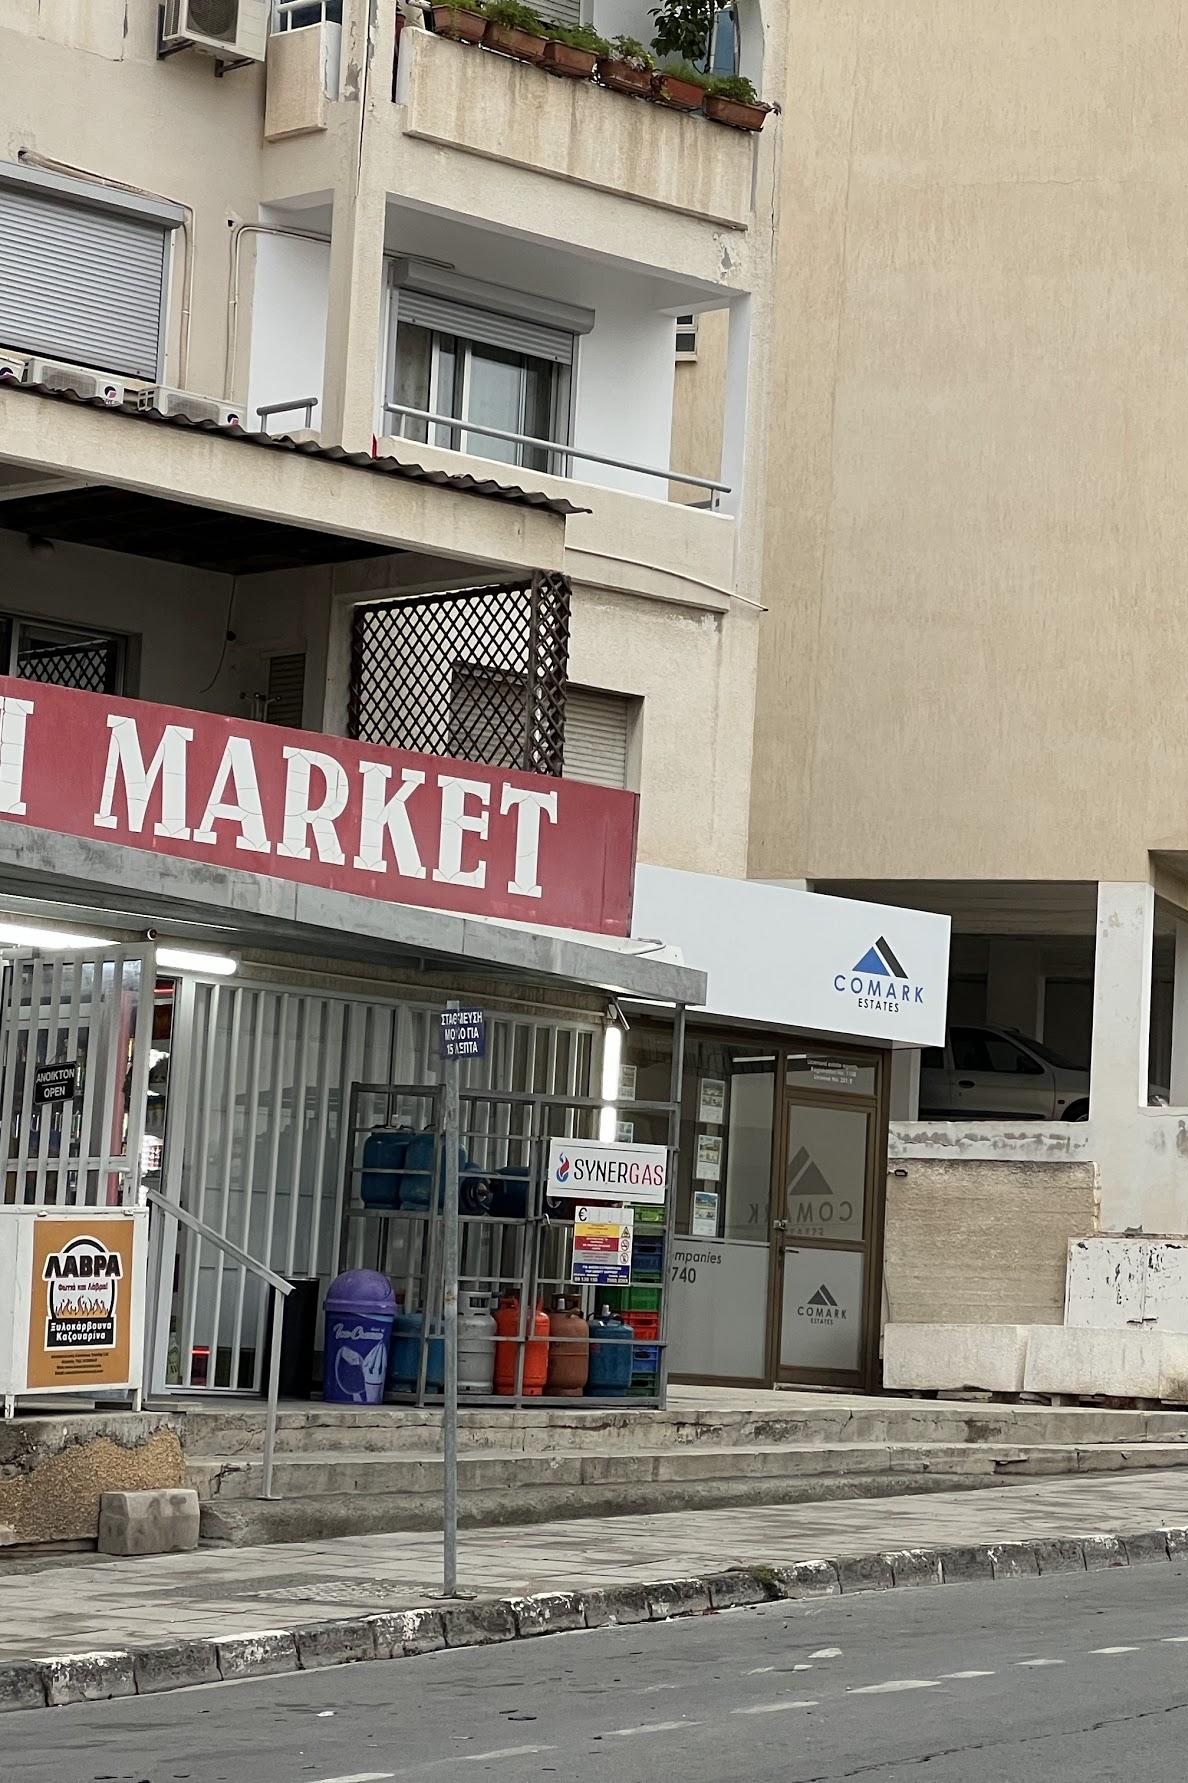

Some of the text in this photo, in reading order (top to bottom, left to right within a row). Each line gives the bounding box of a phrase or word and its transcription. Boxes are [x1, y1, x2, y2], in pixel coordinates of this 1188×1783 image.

[94, 713, 558, 898] MARKET
[834, 974, 924, 1003] COMARK
[858, 998, 899, 1012] ESTATES
[36, 1069, 75, 1083] ΑΝΟΙΚΤΟΝ
[44, 1086, 66, 1098] OPEN
[573, 1158, 664, 1186] SYNERGAS
[674, 1251, 722, 1265] mpanies
[45, 1254, 121, 1278] ΛΑΒΡΑ
[671, 1266, 697, 1283] 740
[797, 1306, 847, 1319] COMARK
[50, 1321, 112, 1332] Ξυλοκάρβουνα
[56, 1331, 106, 1342] Καζουαρίνα
